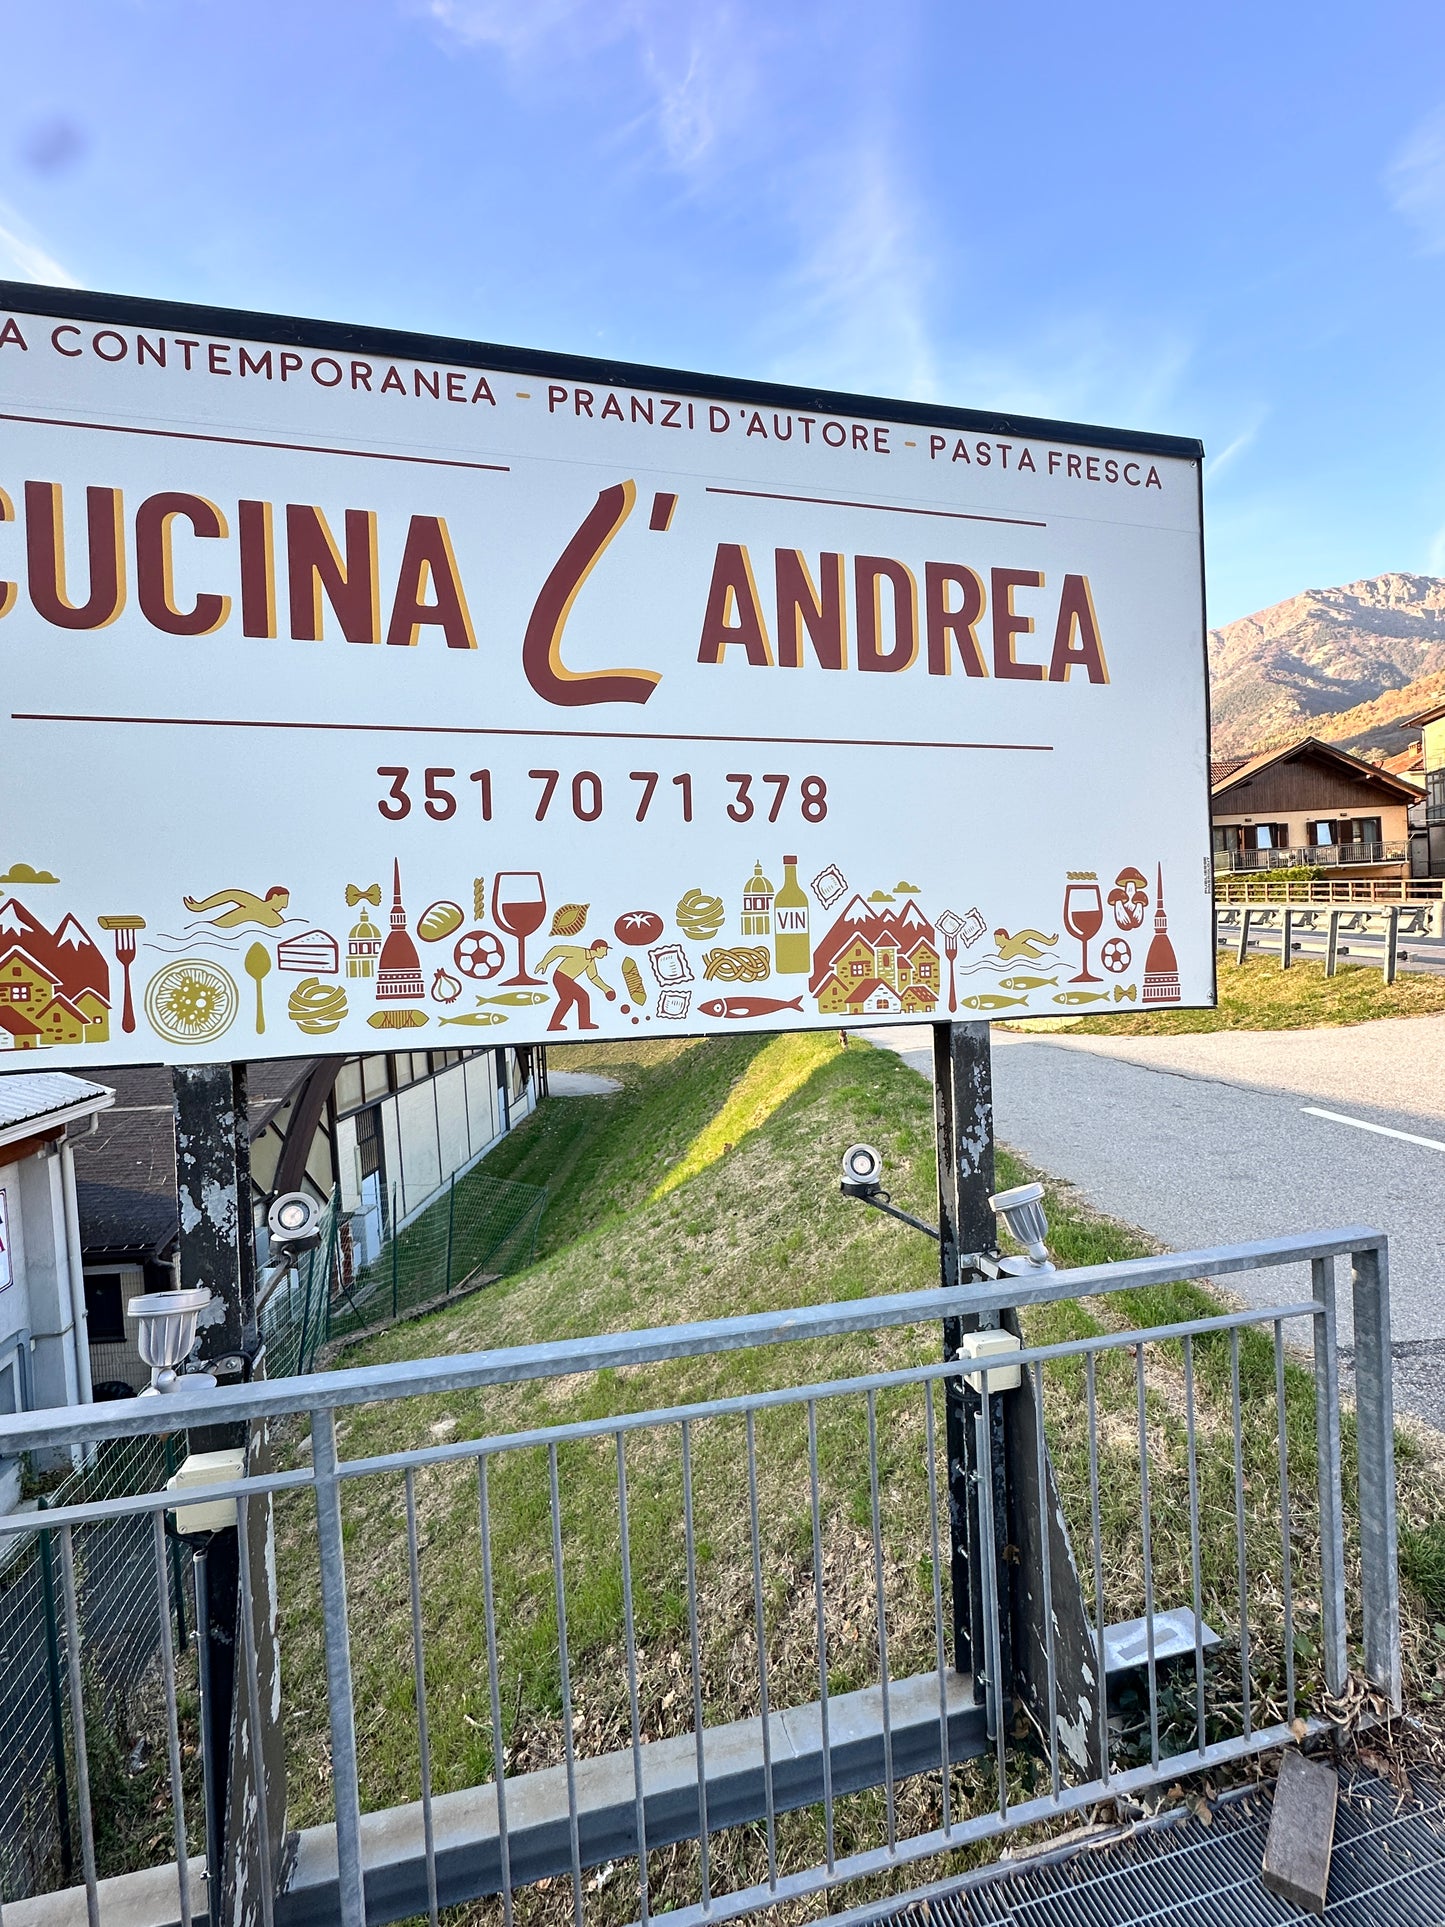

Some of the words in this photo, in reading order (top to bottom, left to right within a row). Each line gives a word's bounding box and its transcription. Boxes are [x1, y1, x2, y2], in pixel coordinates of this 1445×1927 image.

[51, 325, 496, 406] CONTEMPORANEA
[548, 385, 694, 430] PRANZI
[929, 434, 1036, 473] PASTA
[1047, 450, 1163, 491] FRESCA
[0, 480, 479, 650] UCINA
[377, 766, 492, 821] 351
[528, 769, 603, 822] 70
[629, 771, 693, 823] 71
[726, 773, 829, 823] 378
[777, 911, 806, 930] VIN
